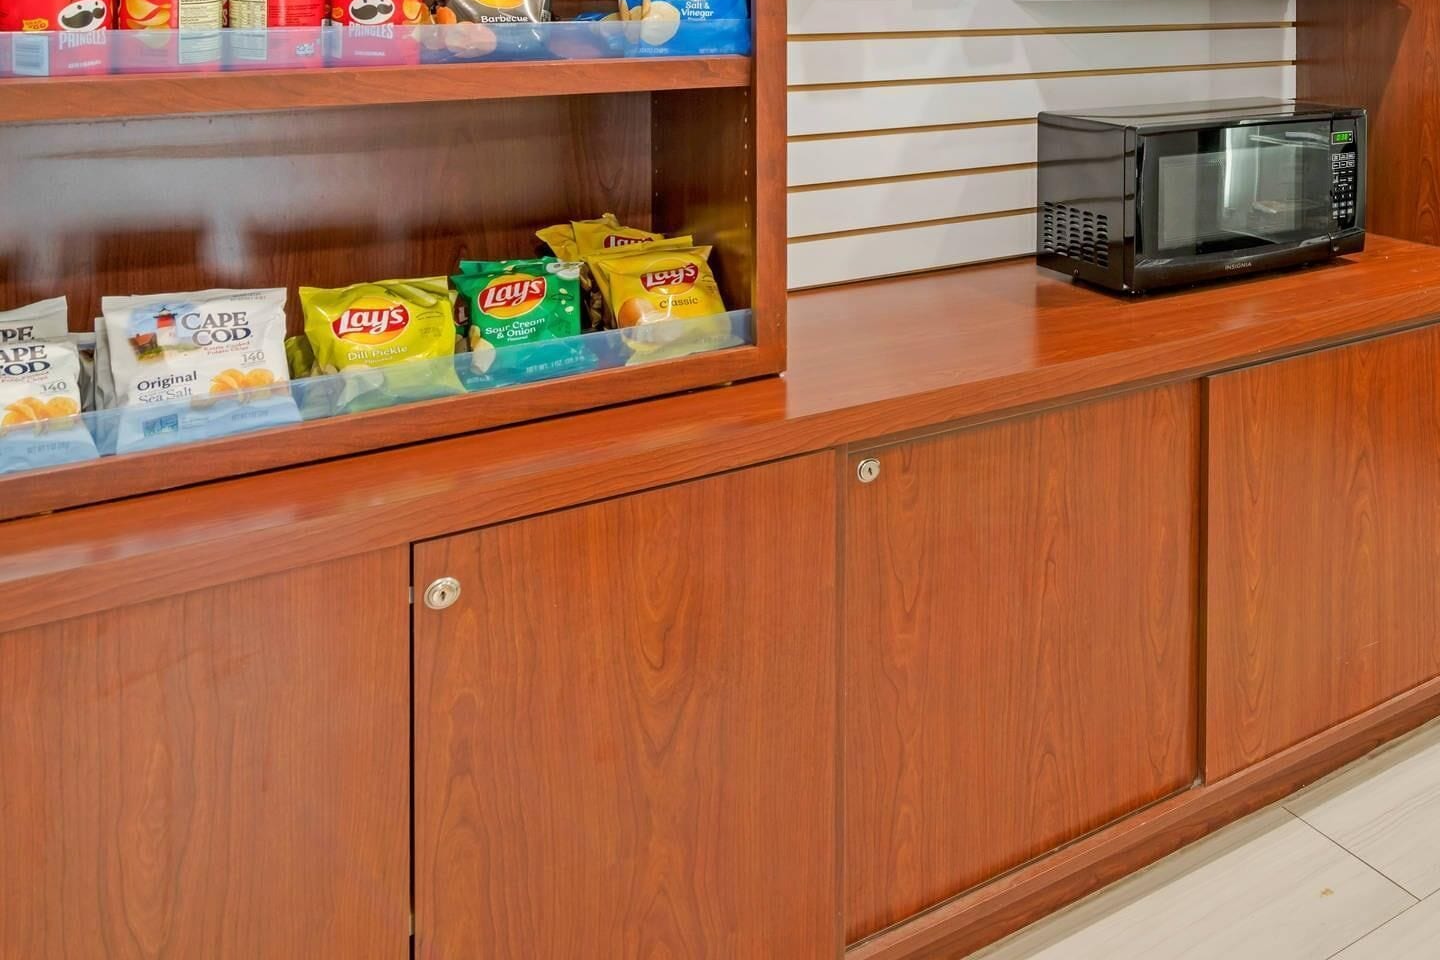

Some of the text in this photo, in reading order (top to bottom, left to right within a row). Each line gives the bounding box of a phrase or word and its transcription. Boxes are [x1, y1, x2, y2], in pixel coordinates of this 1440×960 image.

[681, 8, 714, 19] Vinegar
[685, 1, 703, 10] Salt
[480, 15, 528, 24] Barbecue
[59, 27, 107, 50] PRINGLES
[349, 22, 394, 40] PRINGLES
[1224, 261, 1252, 270] INSIGNIA
[646, 263, 697, 288] Lay's
[484, 279, 545, 309] Lay's
[181, 311, 249, 331] CAPE
[338, 305, 404, 336] Lay's
[485, 317, 546, 336] Sour Cream
[192, 326, 252, 347] COD
[496, 326, 537, 339] & Onion
[242, 350, 265, 362] 140
[347, 345, 408, 361] Dill Pickle
[137, 371, 197, 392] Original
[138, 387, 193, 403] Sea Salt
